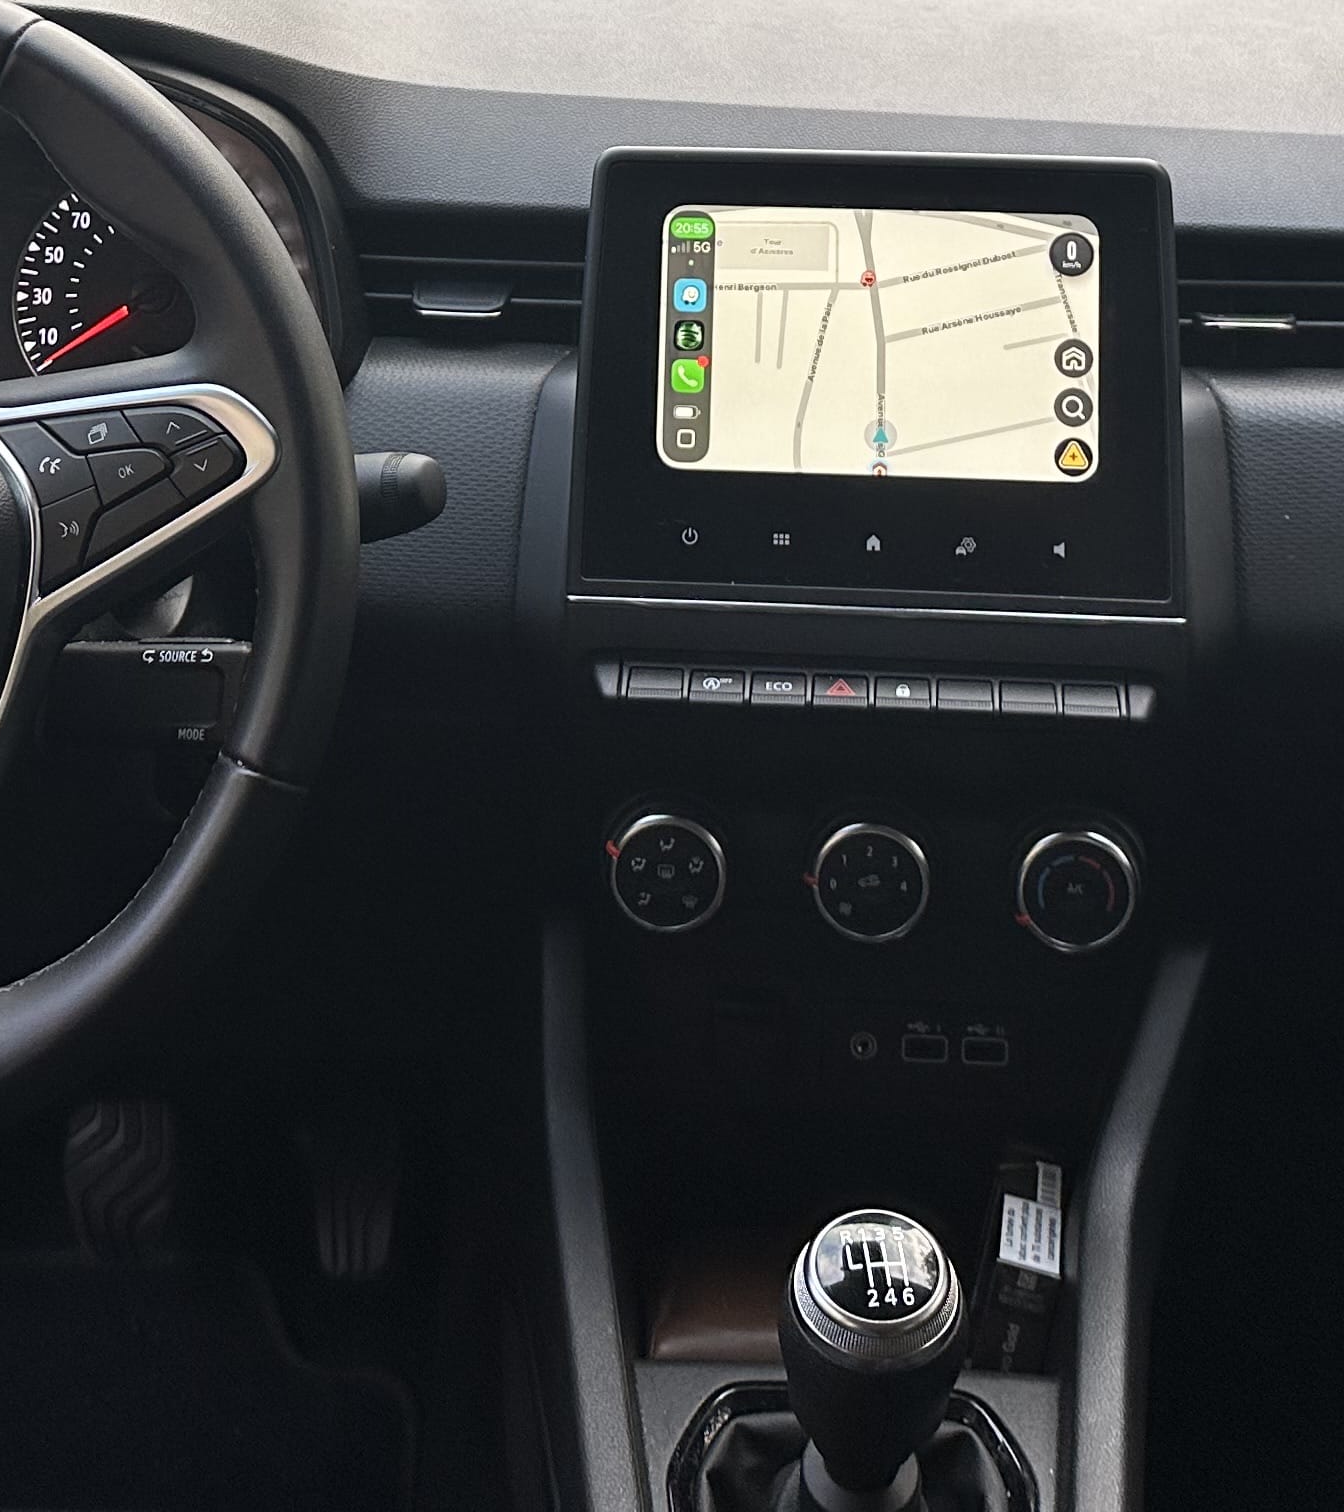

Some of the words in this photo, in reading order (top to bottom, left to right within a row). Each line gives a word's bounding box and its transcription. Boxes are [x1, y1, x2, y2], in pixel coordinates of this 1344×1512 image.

[71, 212, 91, 229] 70
[675, 223, 709, 234] 20:55
[45, 246, 64, 264] 50
[693, 241, 711, 253] 5G
[1066, 240, 1077, 261] 0
[903, 273, 921, 284] Rue
[922, 269, 935, 279] du
[935, 258, 981, 275] Rossignol
[982, 251, 1017, 265] Dubost
[715, 283, 737, 291] enri
[32, 287, 52, 305] 30
[921, 324, 940, 336] Rue
[975, 305, 1022, 323] Houssaye
[39, 327, 58, 345] 10
[807, 348, 822, 382] Avenue
[816, 334, 825, 347] de
[822, 302, 833, 323] Paix
[118, 463, 135, 480] OK
[159, 650, 197, 664] SOURCE
[766, 681, 793, 692] ECO
[177, 727, 205, 742] MODE
[866, 845, 873, 857] 2
[892, 856, 898, 867] 3
[829, 878, 837, 890] 0
[840, 1230, 853, 1245] R
[858, 1228, 867, 1242] 1
[874, 1228, 885, 1241] 3
[892, 1227, 904, 1240] 5
[867, 1289, 880, 1307] 2
[885, 1288, 897, 1306] 4
[903, 1287, 915, 1306] 6
